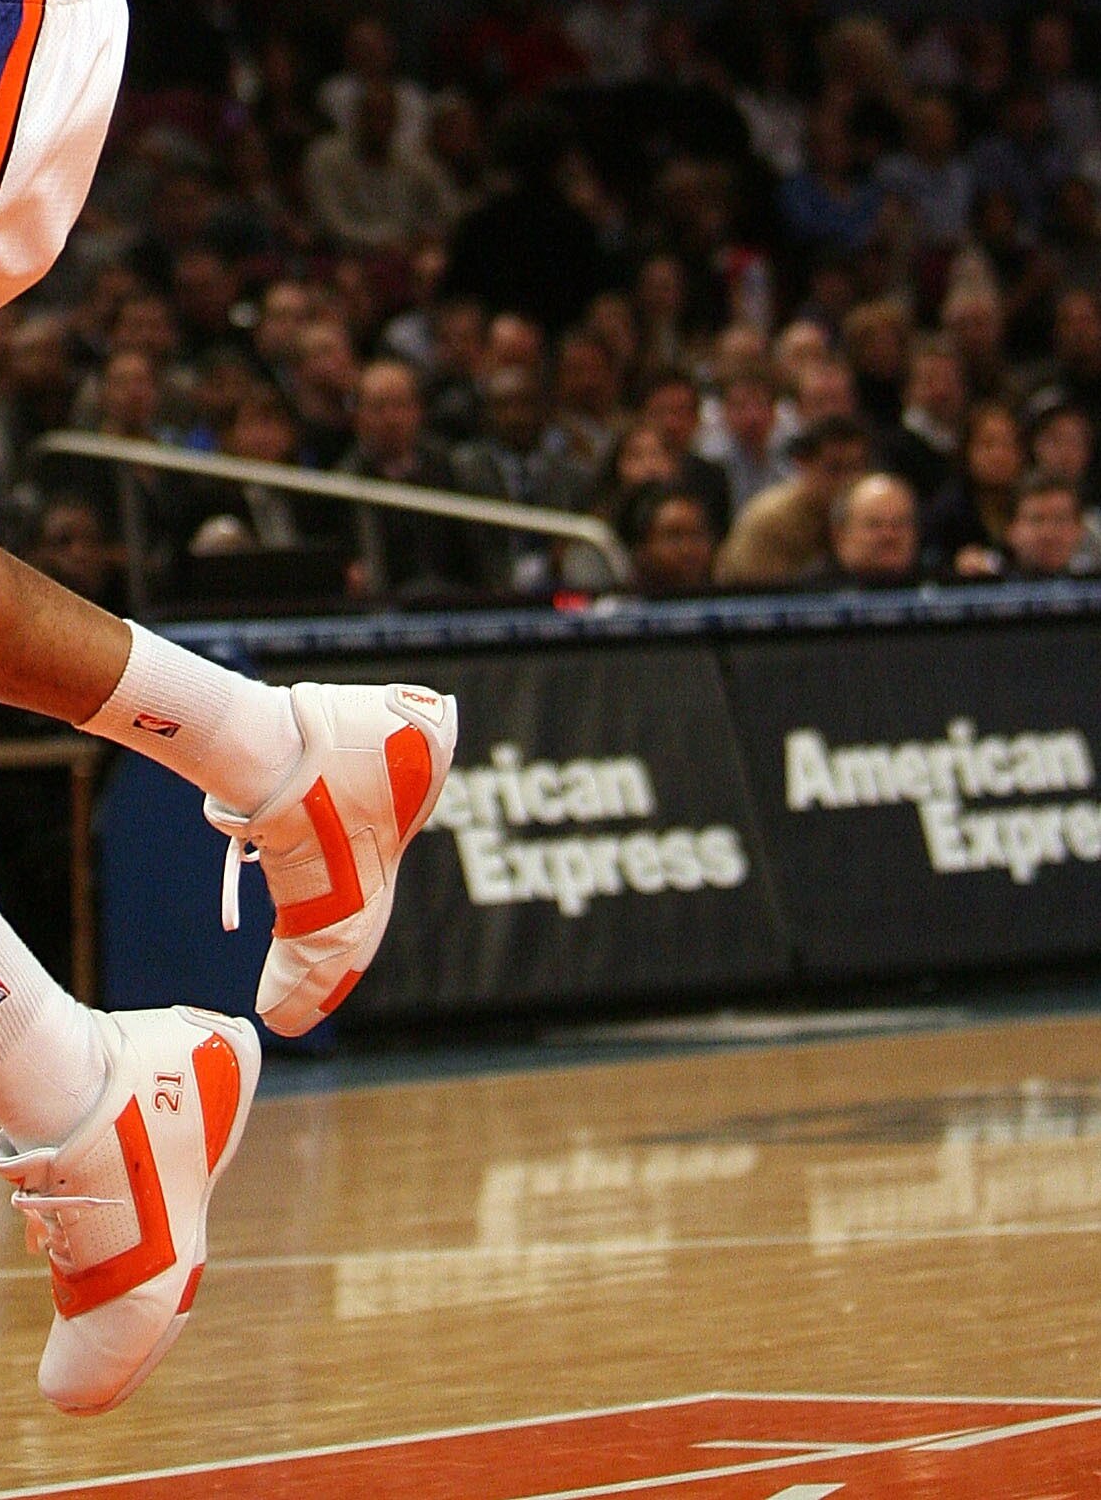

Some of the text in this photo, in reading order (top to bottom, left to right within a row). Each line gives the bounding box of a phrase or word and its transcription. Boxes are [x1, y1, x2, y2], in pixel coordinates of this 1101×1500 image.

[423, 743, 655, 831] erican
[784, 716, 1095, 813] American
[453, 824, 748, 918] Express
[915, 798, 1101, 886] Expre
[152, 1070, 186, 1116] 21
